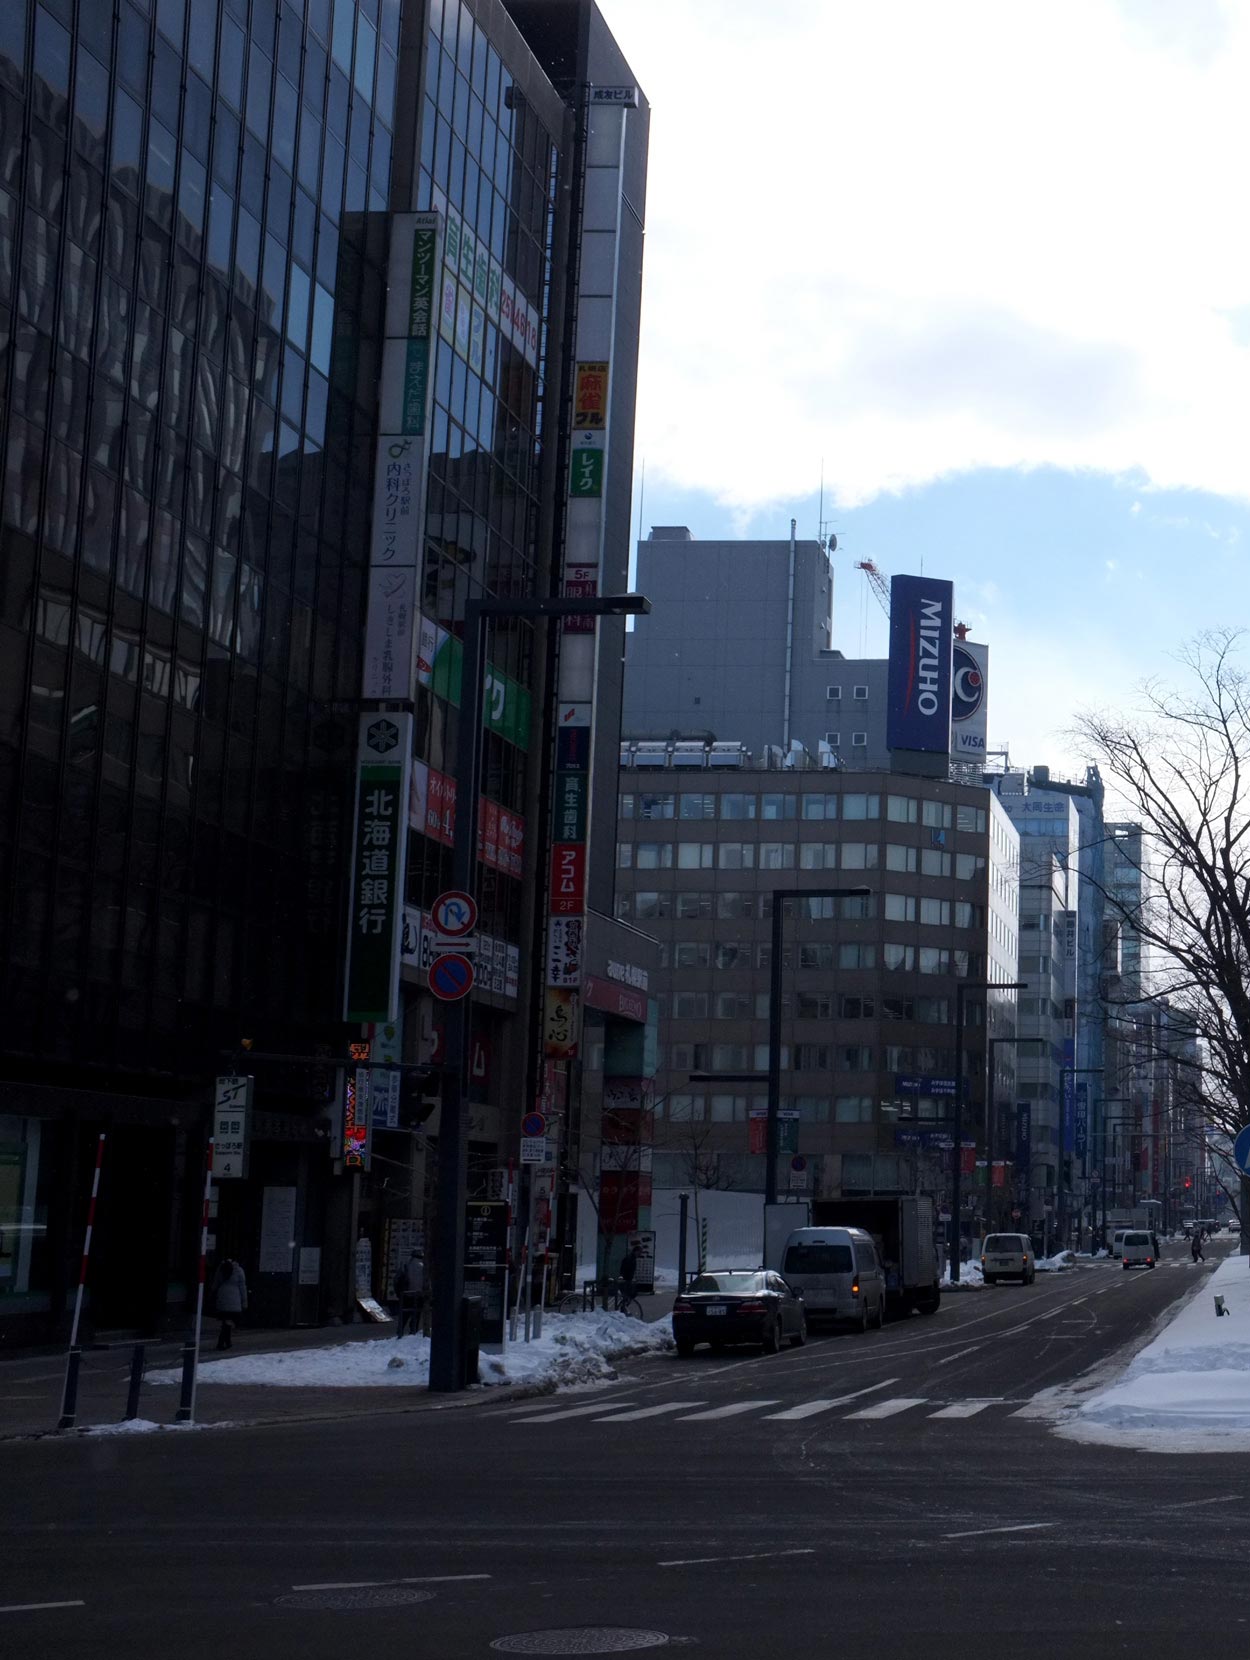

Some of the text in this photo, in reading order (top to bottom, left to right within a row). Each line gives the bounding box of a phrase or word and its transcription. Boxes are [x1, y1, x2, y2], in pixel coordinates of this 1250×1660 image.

[593, 88, 633, 100] 成友ビル
[411, 230, 433, 337] マンツーマン英会話
[580, 374, 602, 410] 麻雀
[578, 452, 593, 491] レイク
[382, 462, 402, 561] 内科クリニック
[574, 569, 590, 580] 5F
[917, 598, 943, 716] MIZUHO
[961, 734, 985, 749] VISA
[1021, 801, 1065, 813] 大同生命
[358, 789, 394, 935] 北海道銀行
[560, 850, 576, 893] アコム
[559, 900, 575, 911] 2F
[217, 1083, 246, 1105] ST
[223, 1163, 231, 1173] 4
